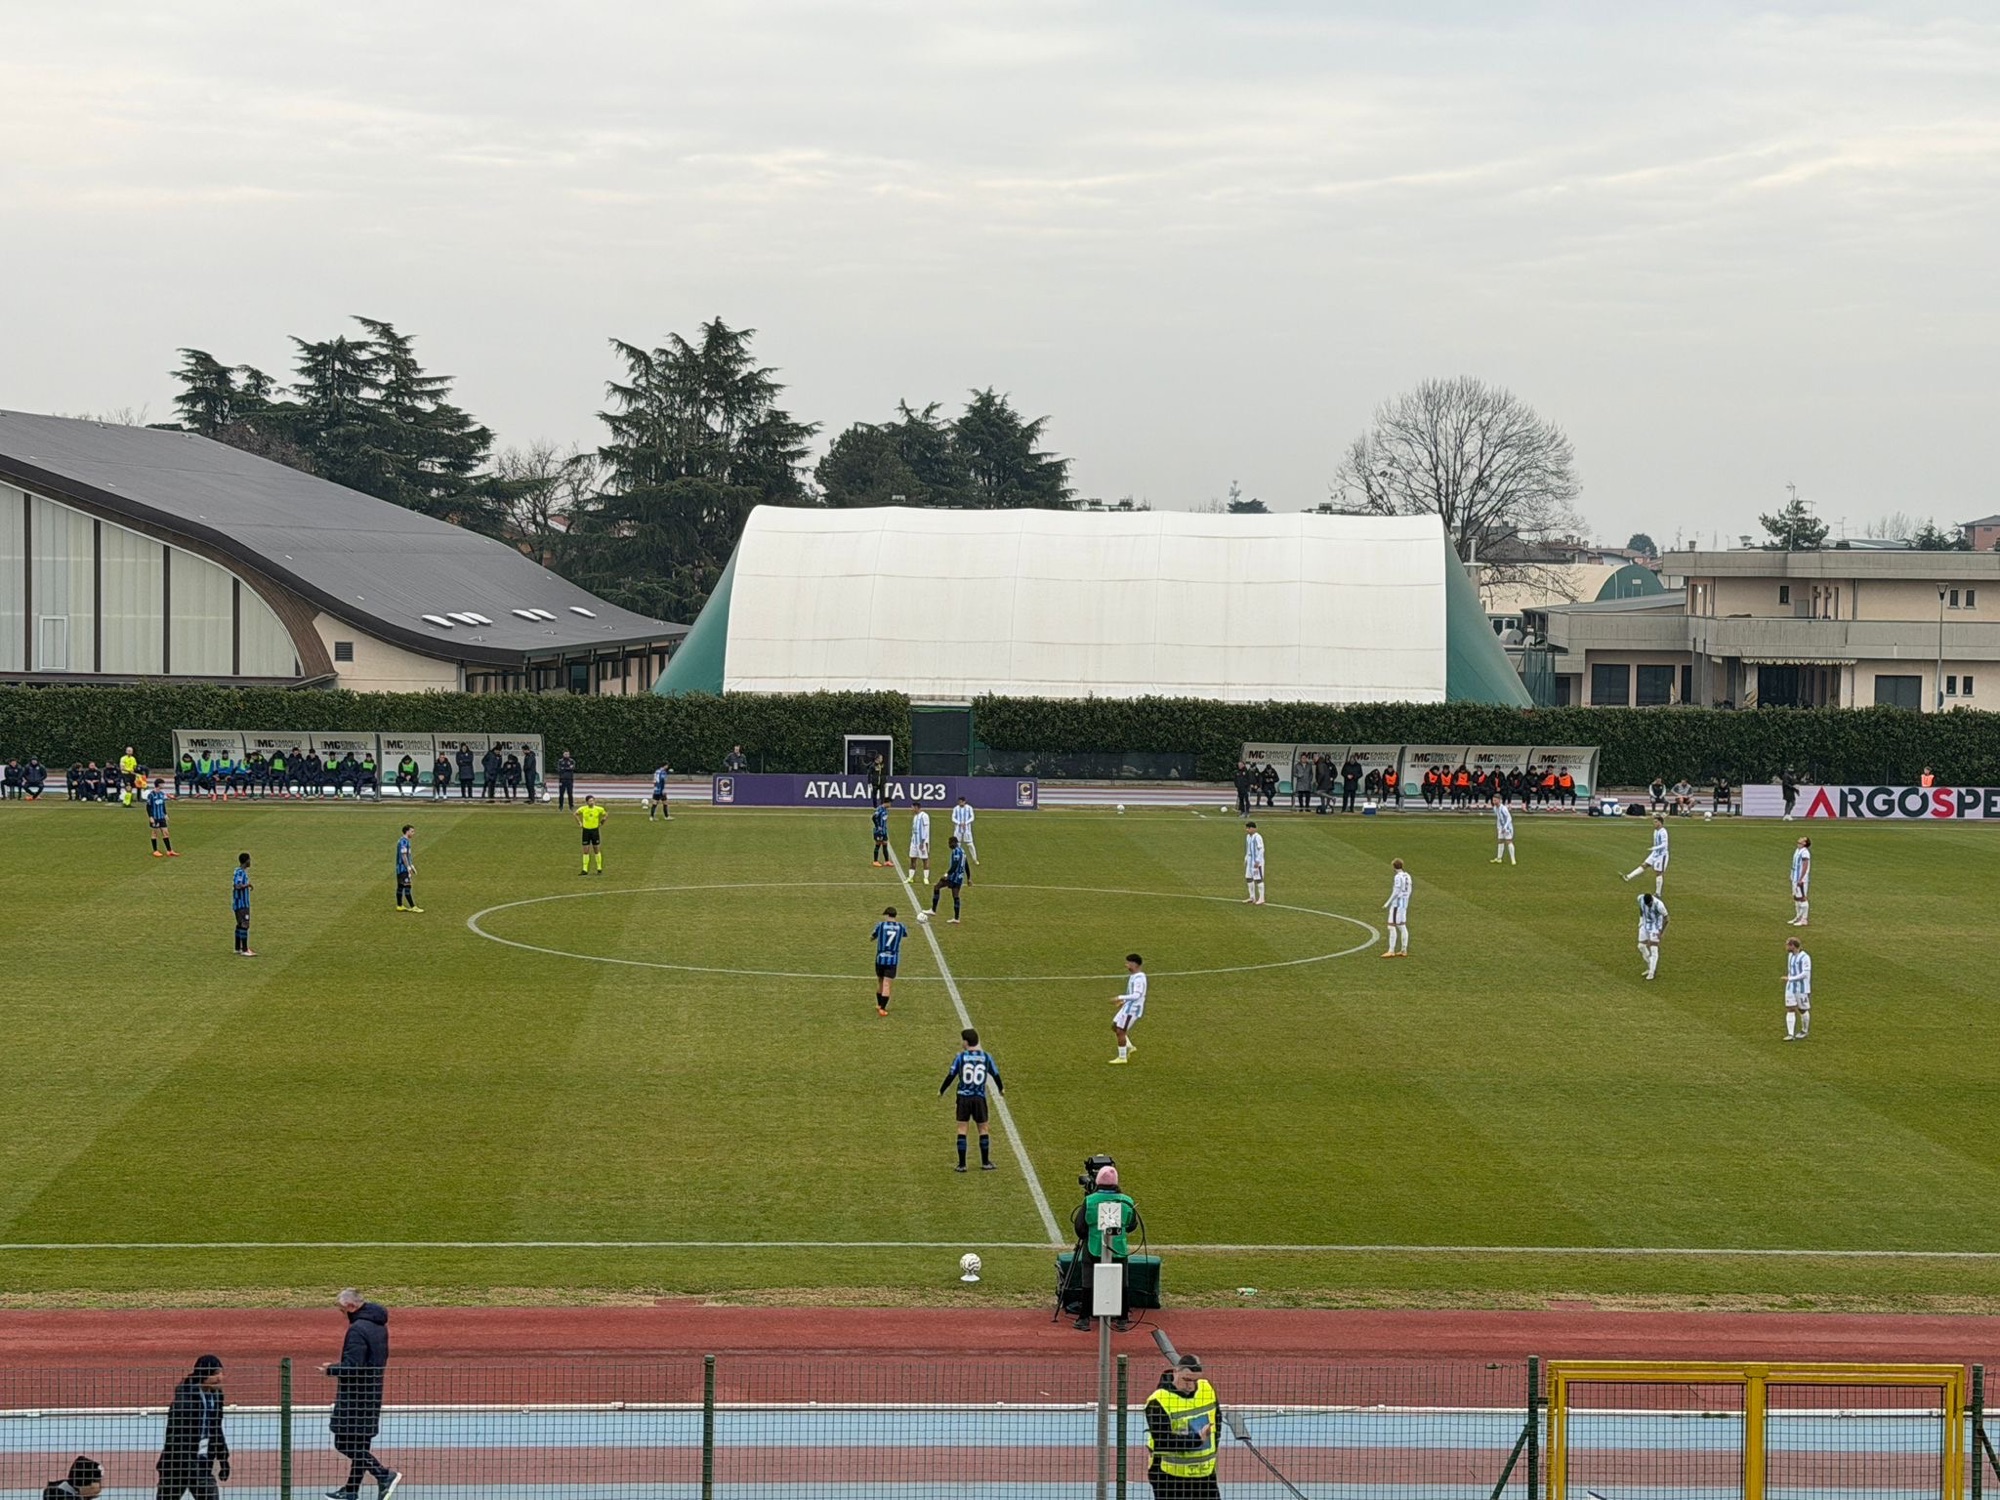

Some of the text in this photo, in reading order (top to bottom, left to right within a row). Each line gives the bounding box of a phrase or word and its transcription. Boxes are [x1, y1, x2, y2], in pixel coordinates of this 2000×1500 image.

[909, 783, 946, 800] U23
[886, 930, 896, 947] 7
[963, 1063, 986, 1085] 66
